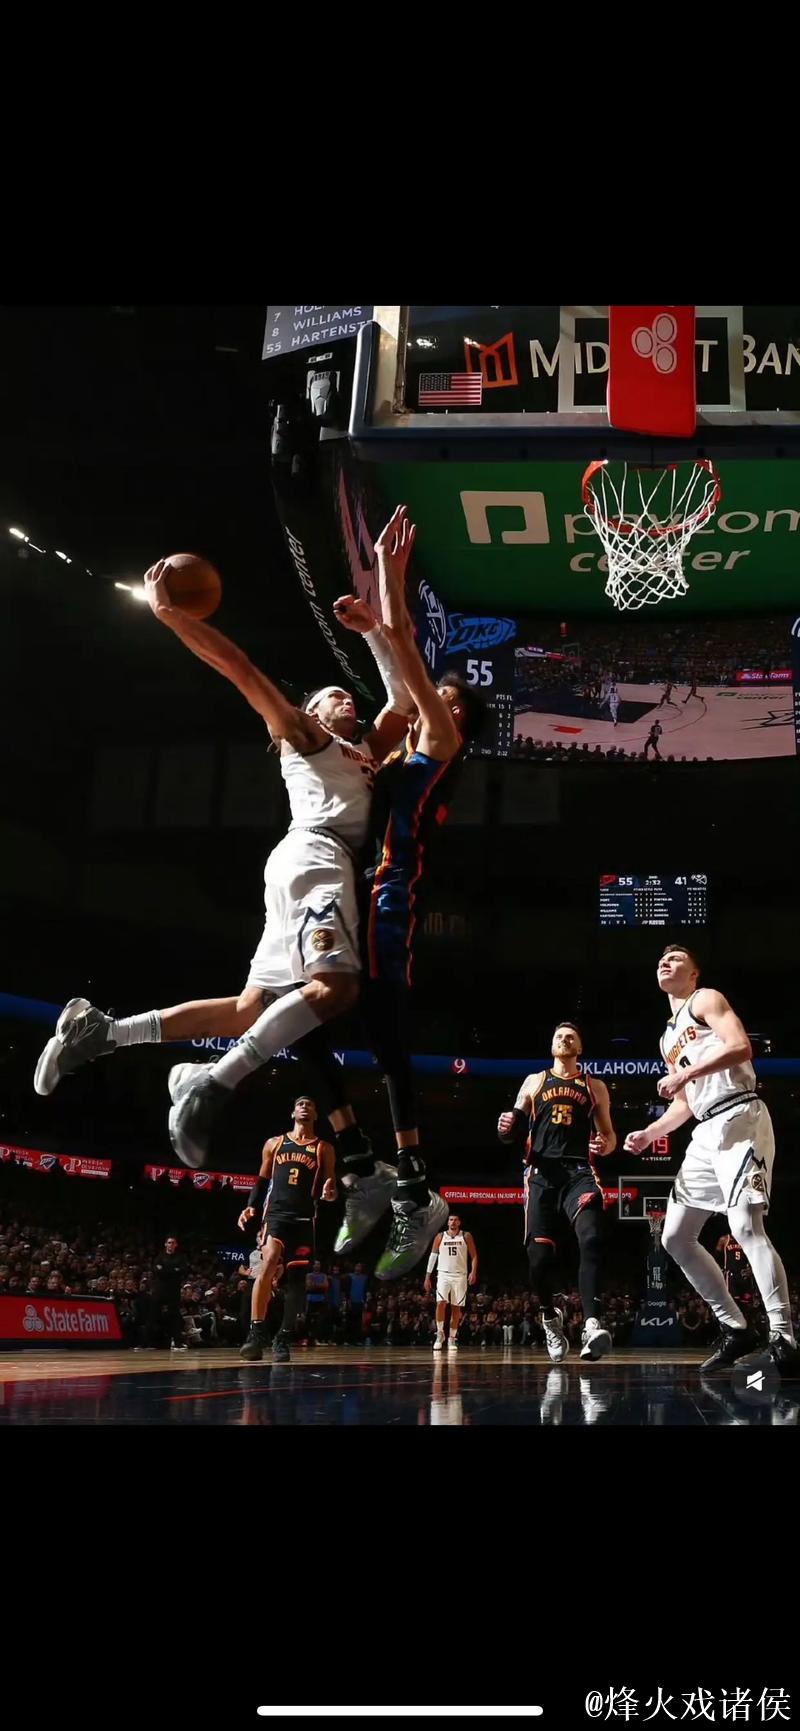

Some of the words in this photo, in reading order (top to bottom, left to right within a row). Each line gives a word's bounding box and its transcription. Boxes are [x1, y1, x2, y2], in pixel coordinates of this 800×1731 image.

[272, 327, 280, 337] 8
[293, 306, 362, 331] WILLIAMS
[273, 312, 281, 322] 7
[266, 341, 282, 354] 55
[291, 320, 371, 347] HARTENST
[465, 658, 494, 687] 55
[618, 876, 633, 886] 55
[674, 876, 687, 886] 41
[551, 1103, 573, 1126] 55
[287, 1167, 300, 1186] 2
[448, 1246, 457, 1256] 15
